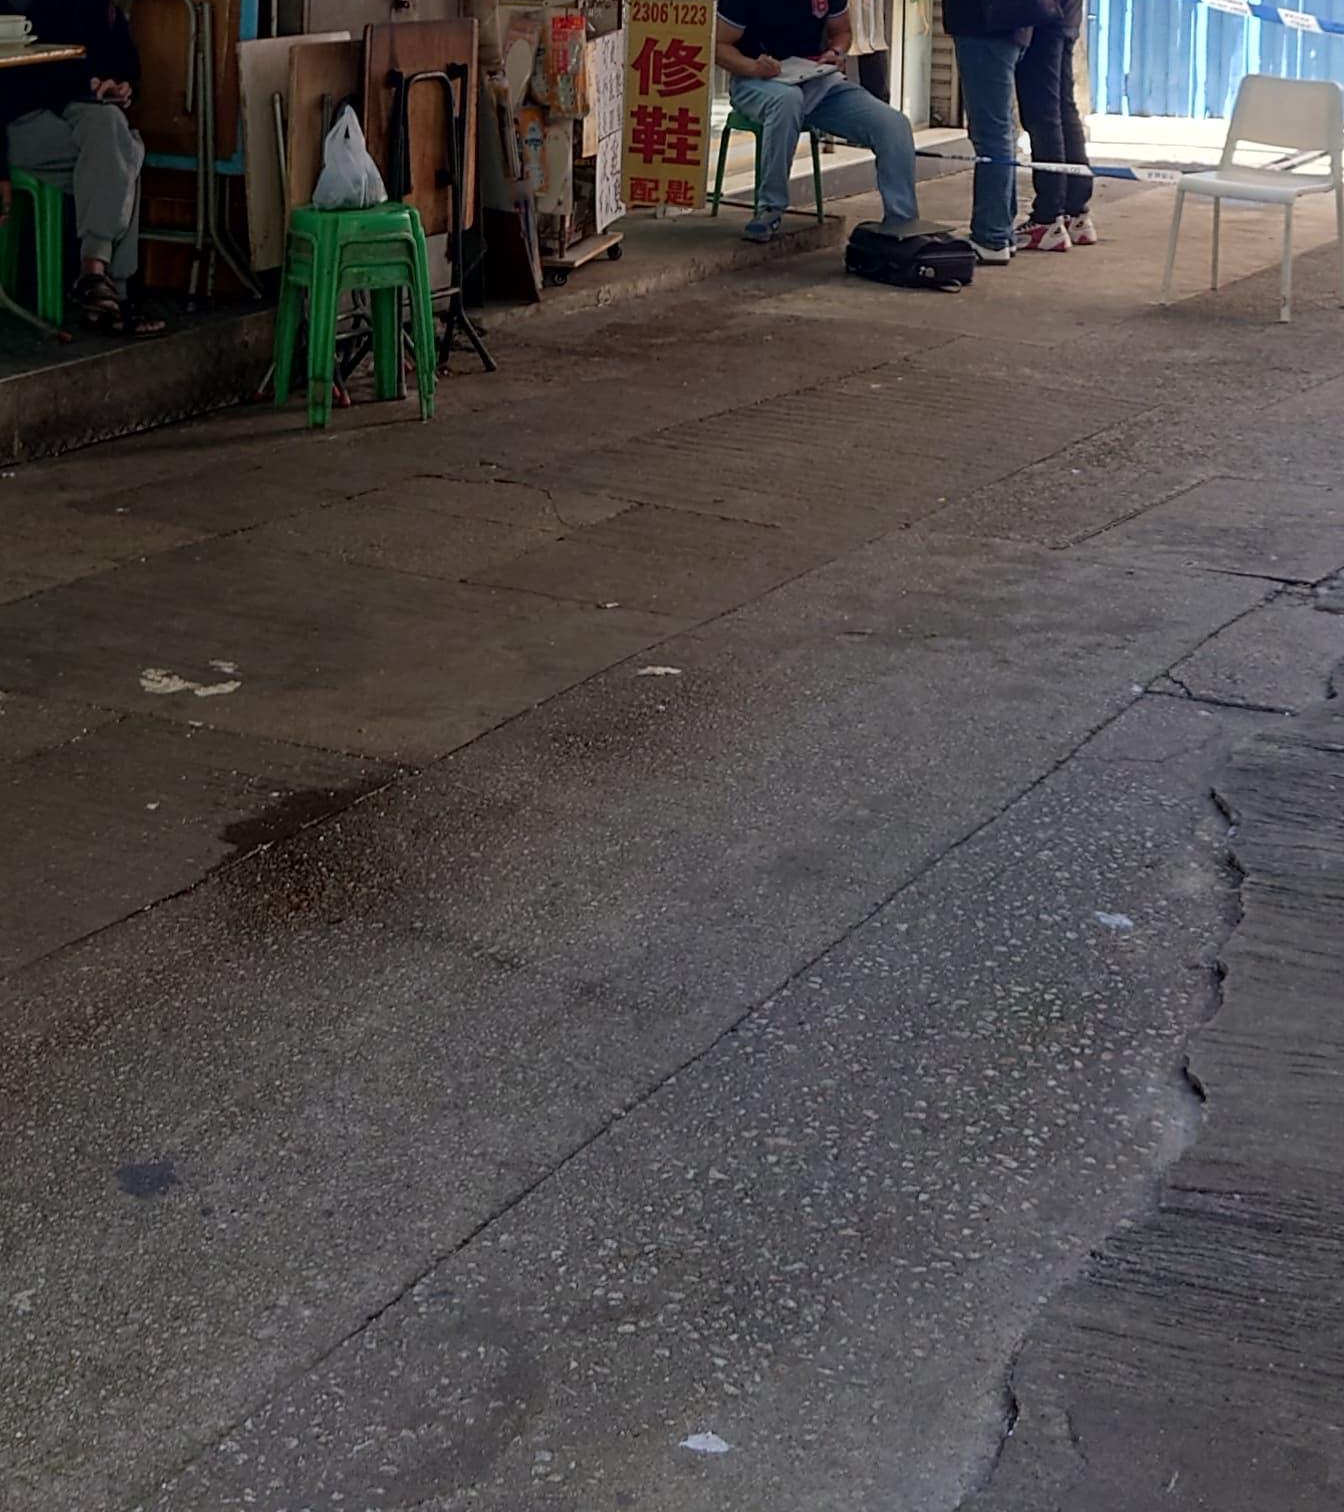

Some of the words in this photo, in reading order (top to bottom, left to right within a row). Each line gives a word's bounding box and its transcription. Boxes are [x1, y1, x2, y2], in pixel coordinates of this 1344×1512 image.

[632, 1, 669, 24] 2306
[672, 4, 707, 26] 1223
[629, 36, 708, 168] 修鞋
[629, 176, 695, 207] 配匙
